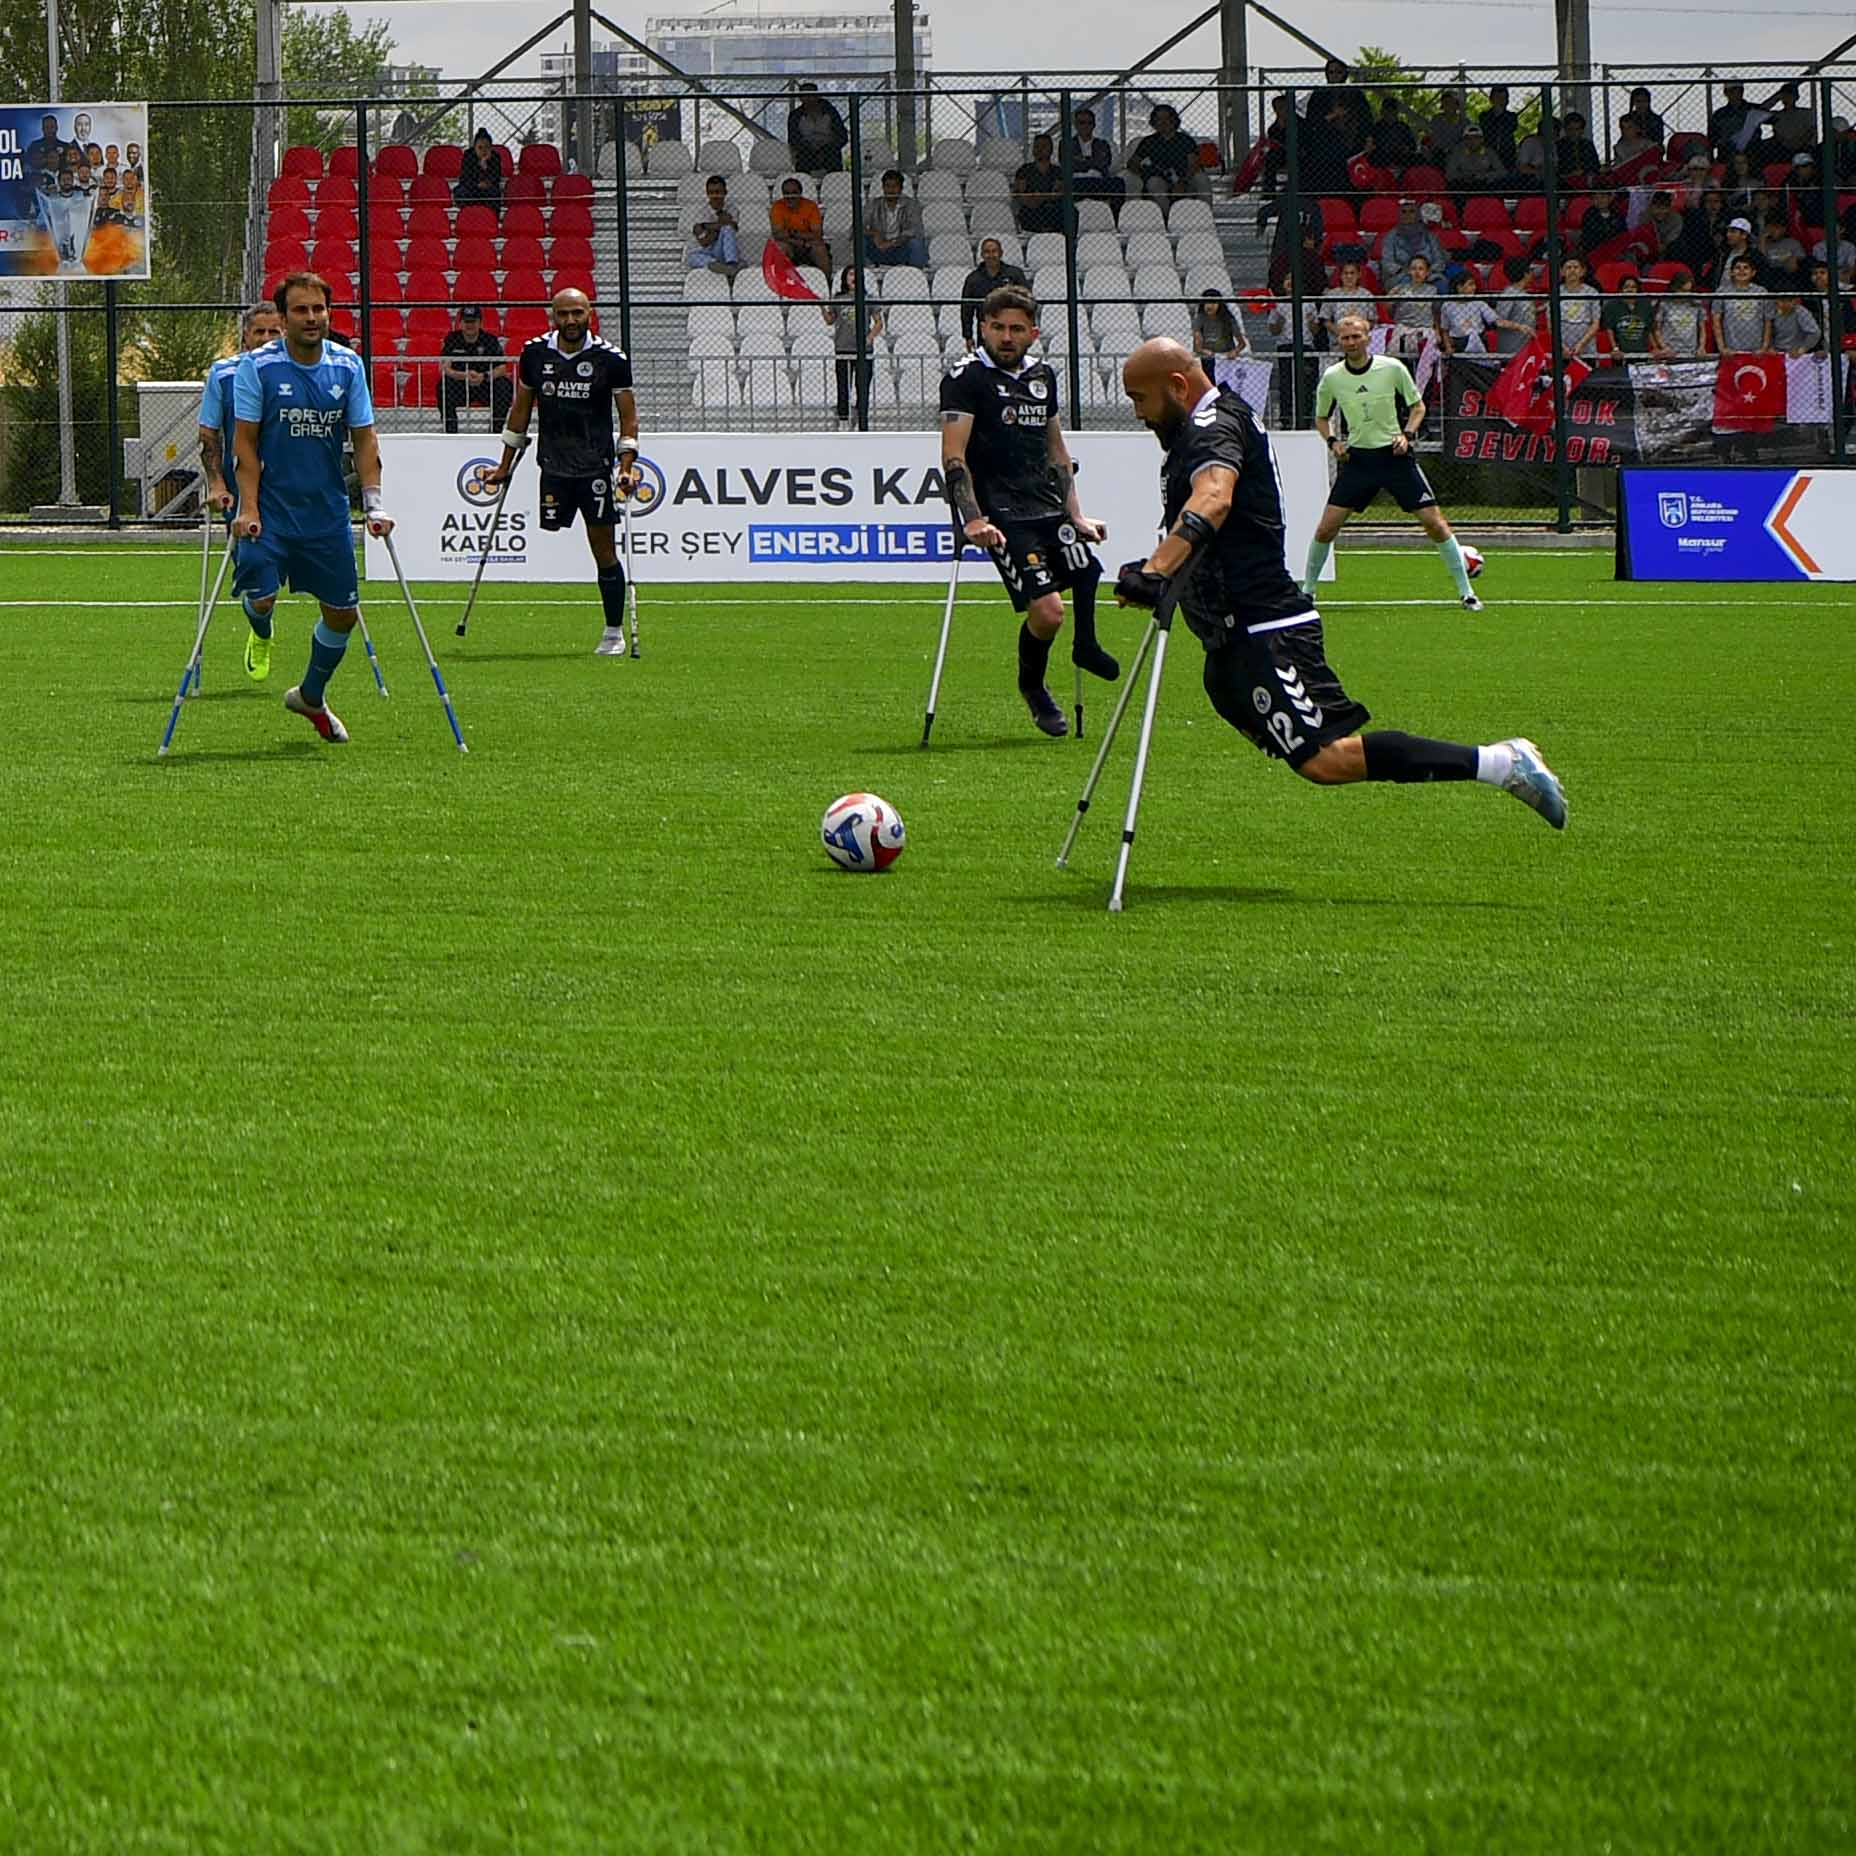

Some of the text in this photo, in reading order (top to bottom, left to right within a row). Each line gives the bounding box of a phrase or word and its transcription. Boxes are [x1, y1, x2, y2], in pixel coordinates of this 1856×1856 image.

[557, 381, 590, 391] ALVES
[557, 390, 590, 399] KABLO
[1570, 399, 1619, 427] OK
[672, 467, 854, 506] ALVES
[593, 496, 605, 519] 7
[441, 513, 526, 531] ALVES
[441, 534, 527, 552] KABLO
[615, 531, 670, 555] HER
[681, 531, 742, 560] ŞEY
[753, 525, 870, 555] ENERJİ
[878, 525, 927, 555] İLE
[1060, 542, 1089, 572] 10
[1266, 711, 1305, 755] 12
